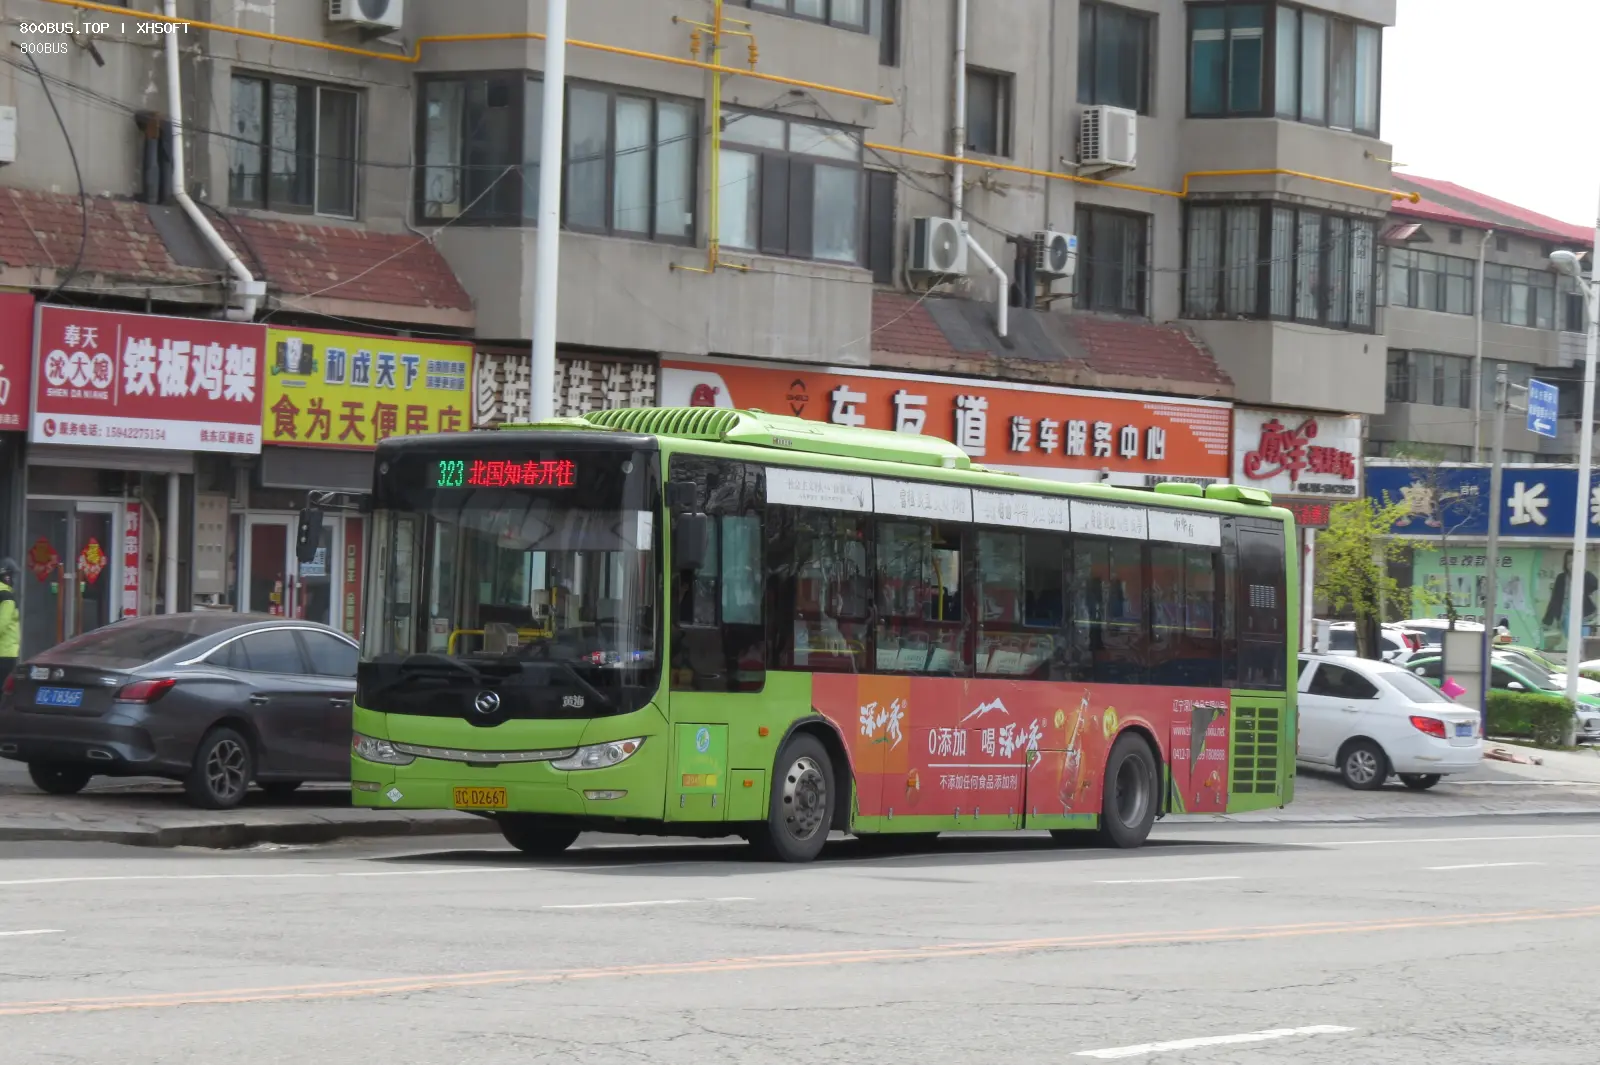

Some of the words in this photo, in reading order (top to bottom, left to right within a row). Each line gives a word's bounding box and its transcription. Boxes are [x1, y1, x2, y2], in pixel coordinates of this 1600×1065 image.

[64, 324, 98, 349] 奉天
[49, 355, 110, 384] 沈大娘
[123, 335, 257, 403] 铁板鸡架
[324, 347, 421, 391] 和成天下
[47, 388, 68, 397] SHEN
[270, 393, 462, 442] 食为天便民店
[1010, 414, 1167, 461] 汽车服务中心
[437, 460, 464, 487] 323
[467, 459, 576, 487] 北国知春开往
[562, 694, 585, 709] 黄海
[928, 726, 968, 758] 0添加
[939, 774, 1019, 790] 不添加任何食品添加剂
